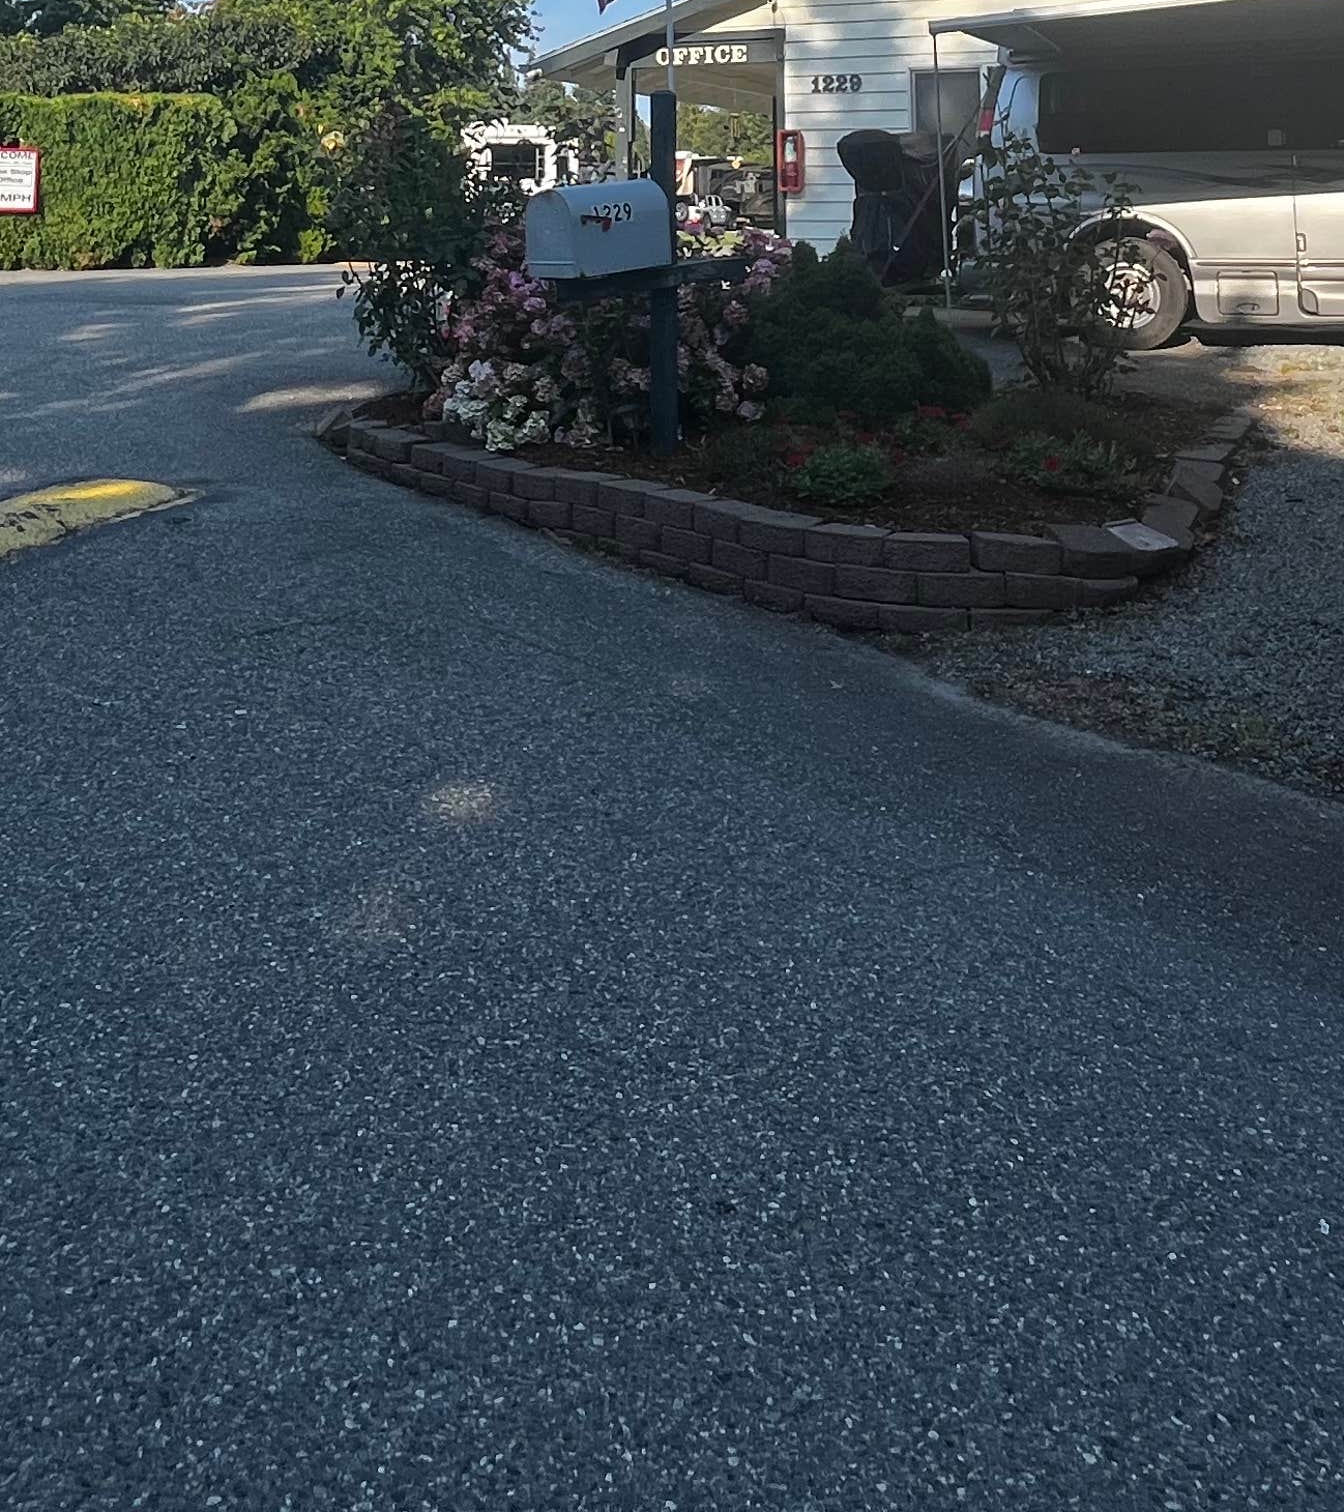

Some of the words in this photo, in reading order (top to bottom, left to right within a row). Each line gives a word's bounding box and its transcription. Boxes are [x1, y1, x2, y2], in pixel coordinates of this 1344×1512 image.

[656, 45, 747, 66] OFFICE
[811, 74, 862, 94] 1229
[0, 193, 32, 202] MPH
